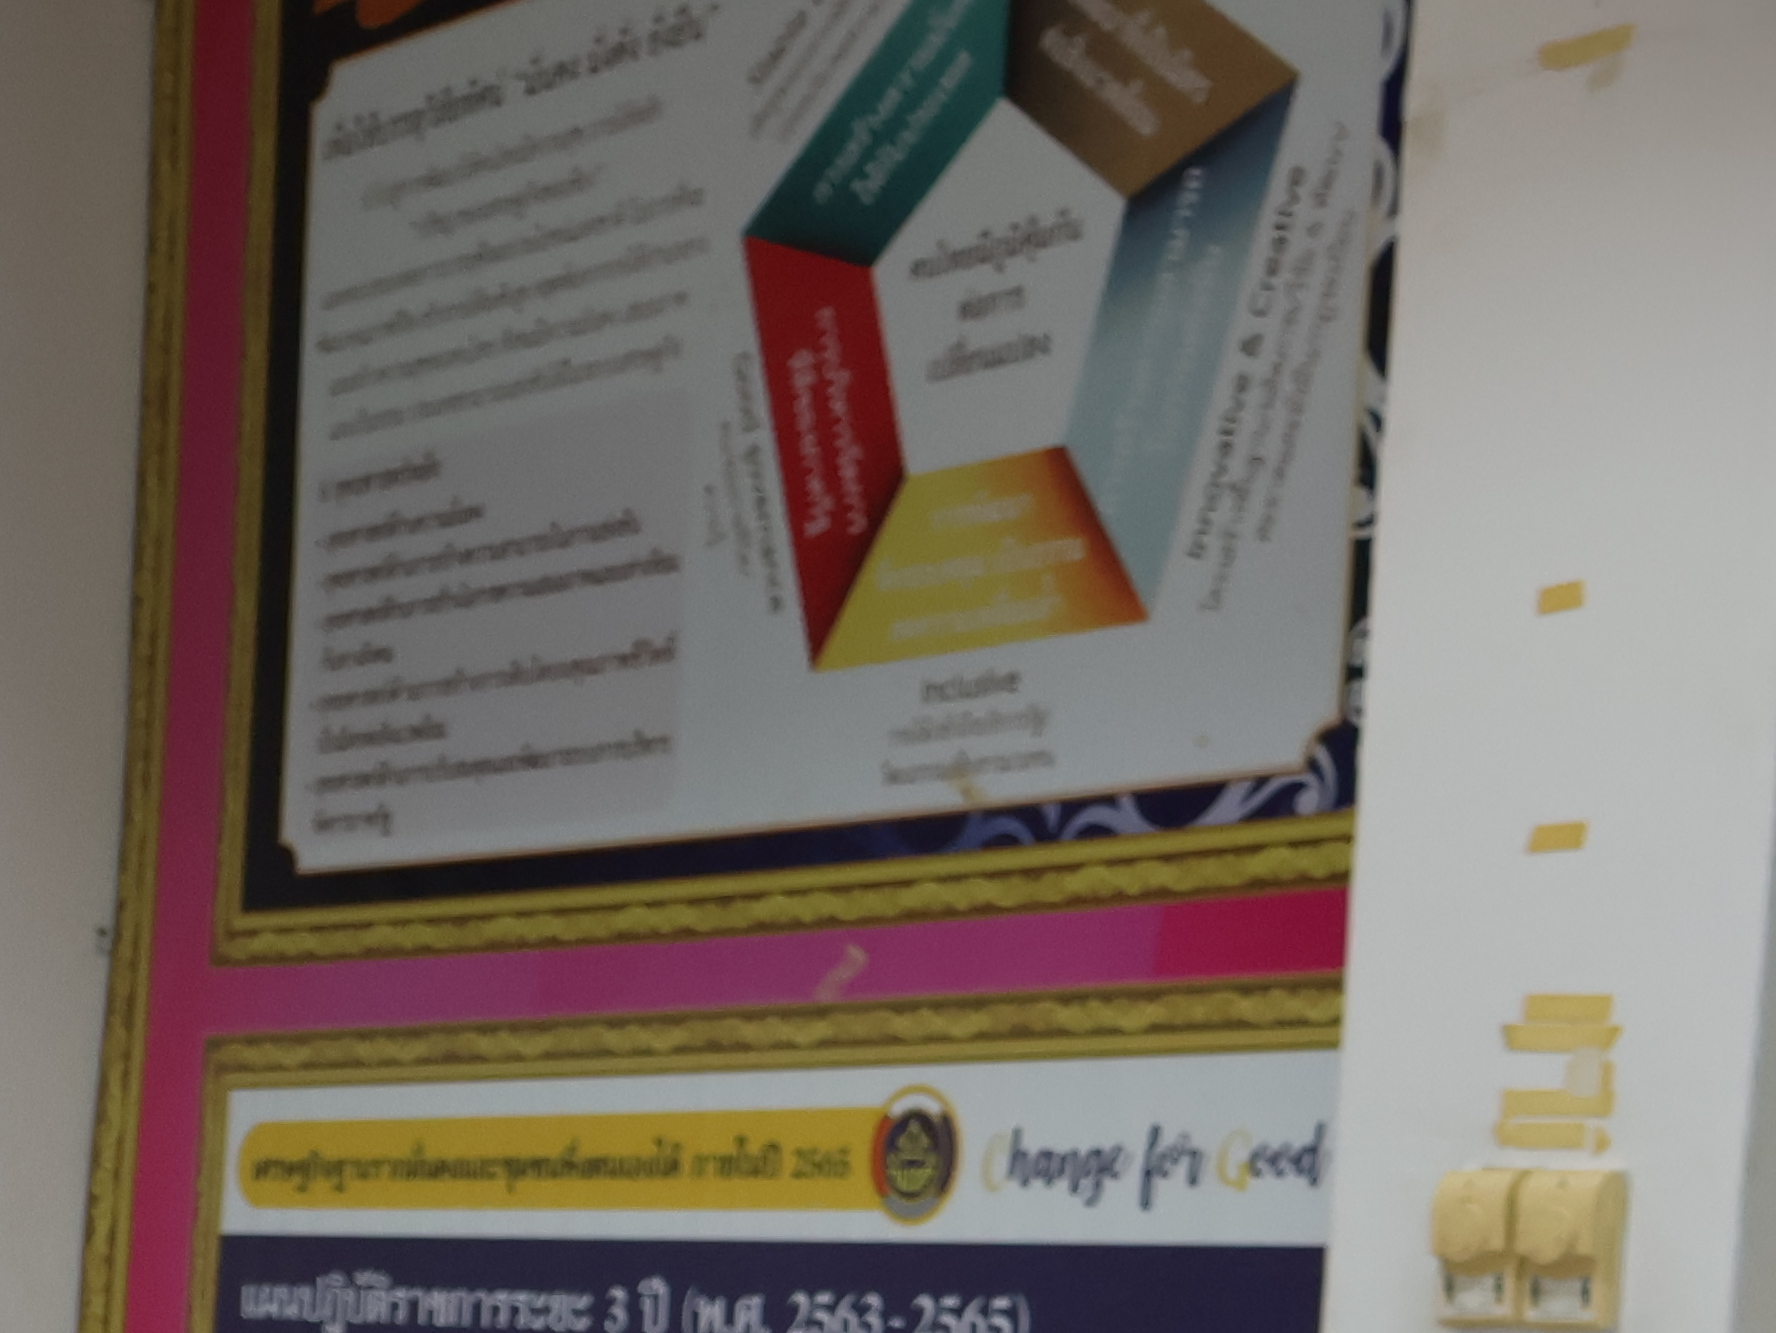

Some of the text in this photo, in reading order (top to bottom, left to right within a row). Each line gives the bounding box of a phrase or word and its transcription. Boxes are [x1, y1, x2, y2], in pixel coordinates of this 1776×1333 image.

[982, 1120, 1327, 1212] Change for Good
